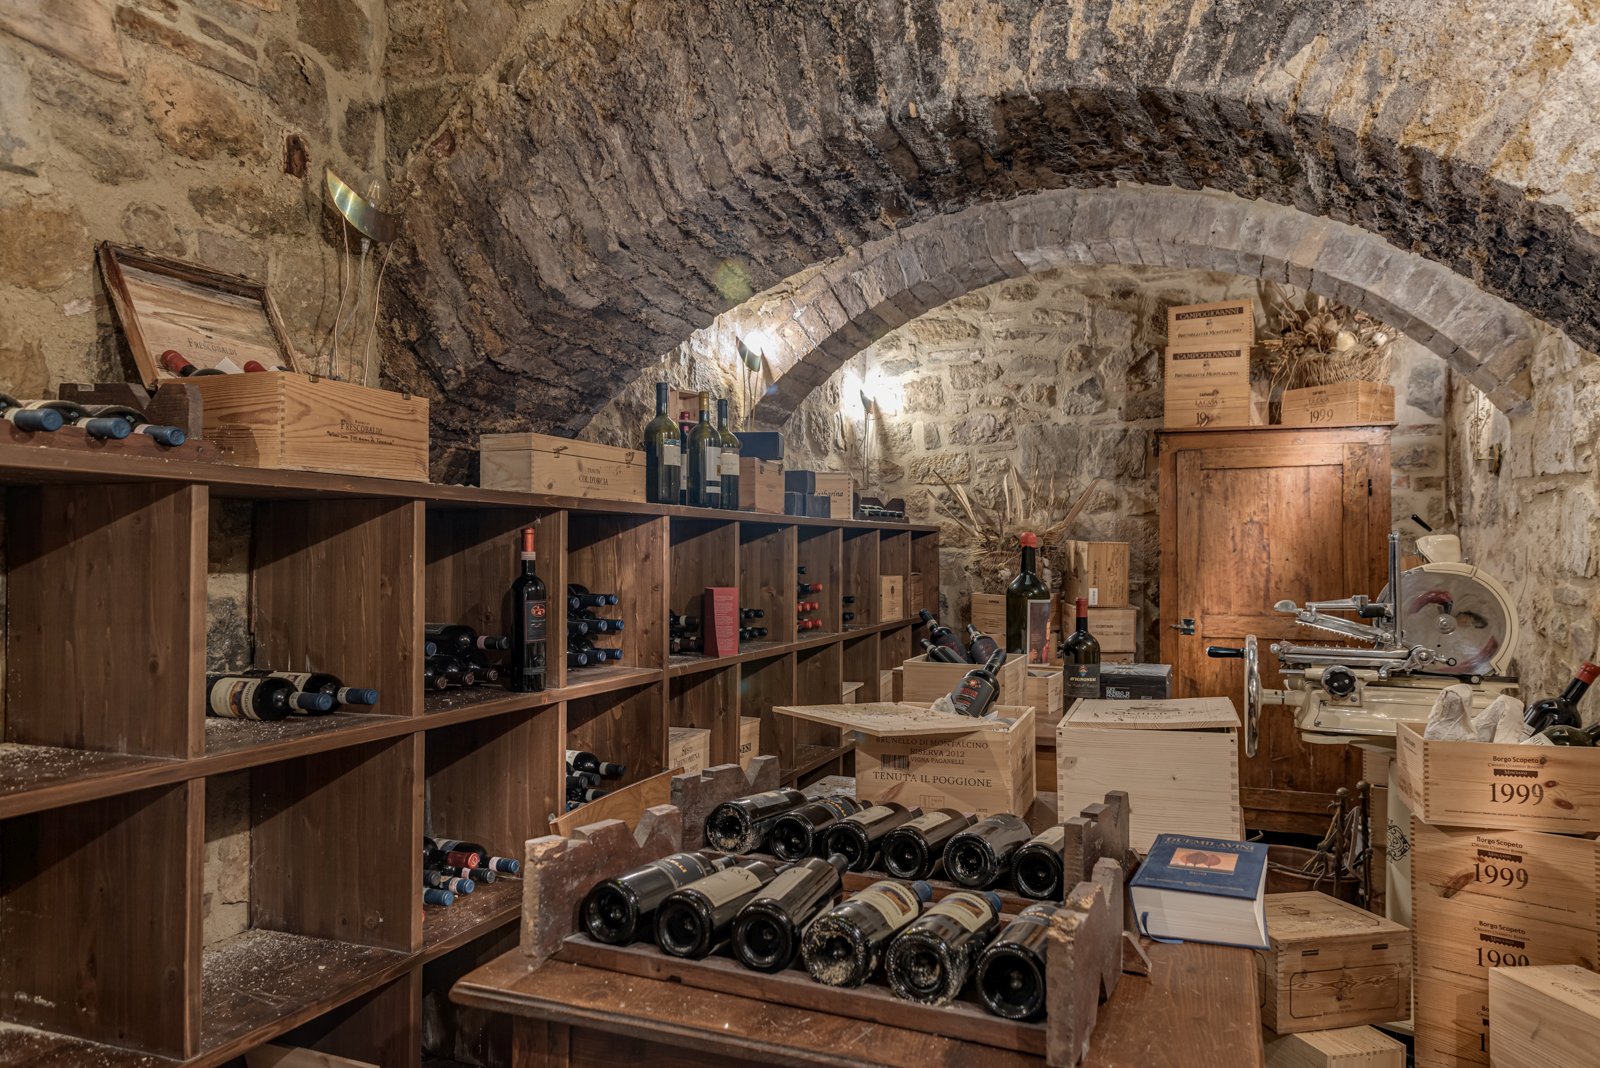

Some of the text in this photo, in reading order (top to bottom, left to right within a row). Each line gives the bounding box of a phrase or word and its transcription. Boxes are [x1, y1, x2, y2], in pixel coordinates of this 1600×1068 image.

[1179, 307, 1240, 320] CAMPOGIOVANNI
[1177, 350, 1238, 360] CAMPOGIOVANNI
[1310, 408, 1334, 424] 1999
[340, 419, 383, 436] FRESCOBALDI
[876, 736, 989, 749] BRUNELLO DI MONTALCINO
[910, 748, 966, 758] RISERVA 2012
[910, 756, 965, 765] VIGNA PAGANELLI
[872, 771, 993, 788] TENUTA IL POGGIONE
[1489, 782, 1544, 806] 1999
[1166, 837, 1254, 854] DUEMILAVINI
[1476, 836, 1523, 849] Borgo Scopeto
[1473, 862, 1529, 889] 1999
[1479, 920, 1526, 935] Borgo Scopeto
